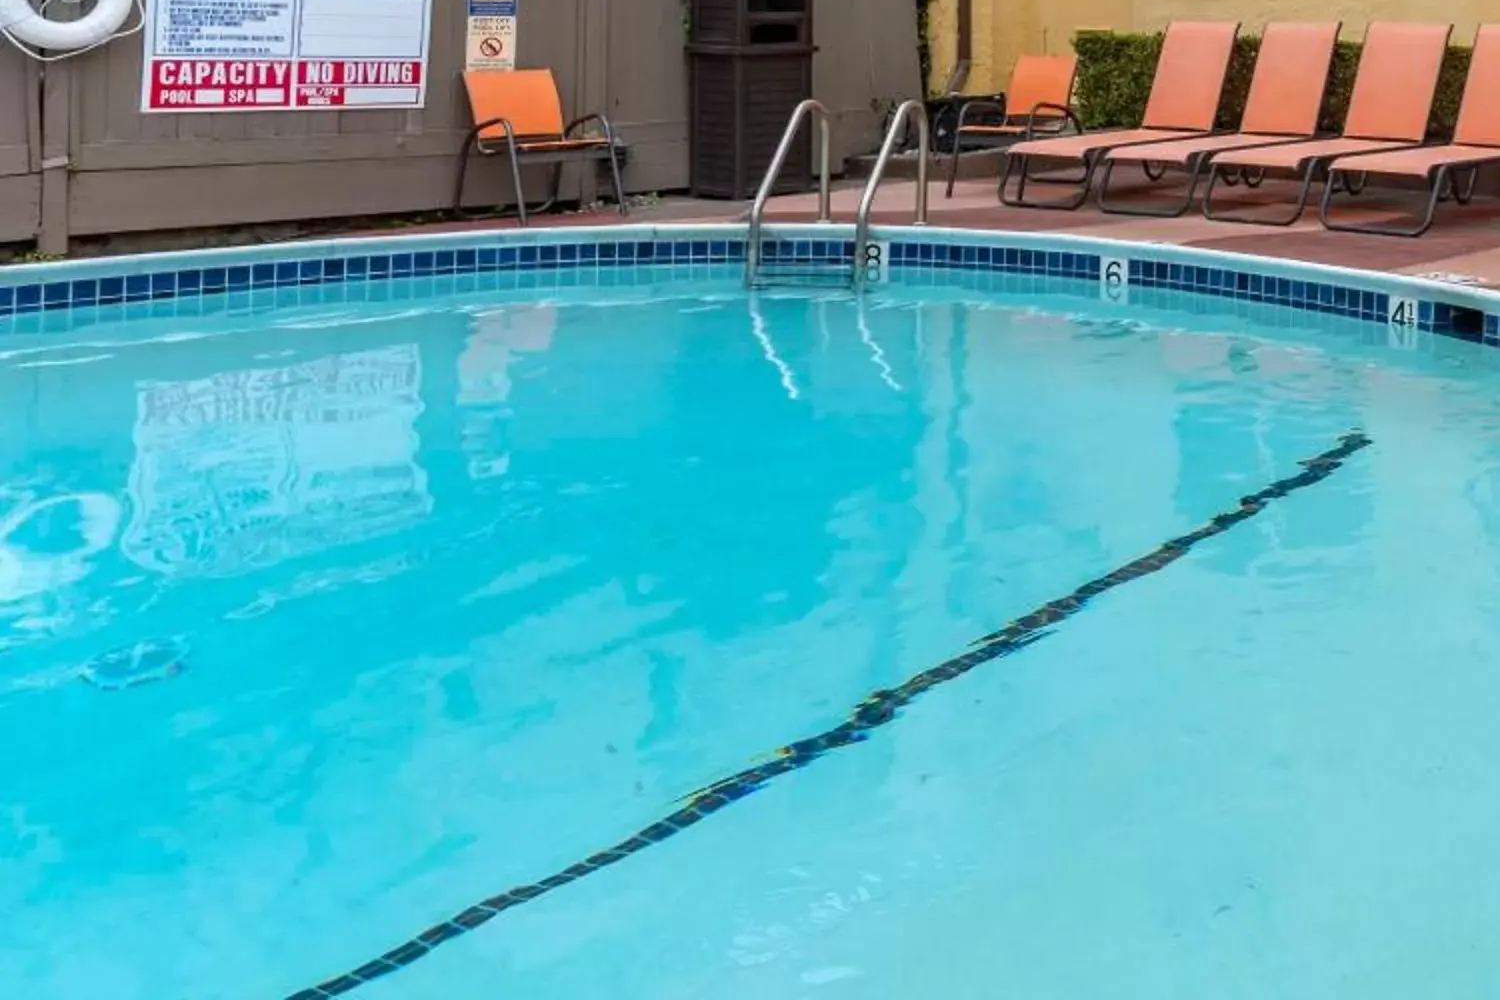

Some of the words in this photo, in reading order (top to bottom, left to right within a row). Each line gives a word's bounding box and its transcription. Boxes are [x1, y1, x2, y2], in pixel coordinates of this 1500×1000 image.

[160, 61, 288, 86] CAPACITY
[306, 62, 334, 83] NO
[343, 62, 414, 84] DIVING
[160, 88, 195, 105] POOL
[228, 88, 255, 104] SPA
[1105, 261, 1121, 288] 6
